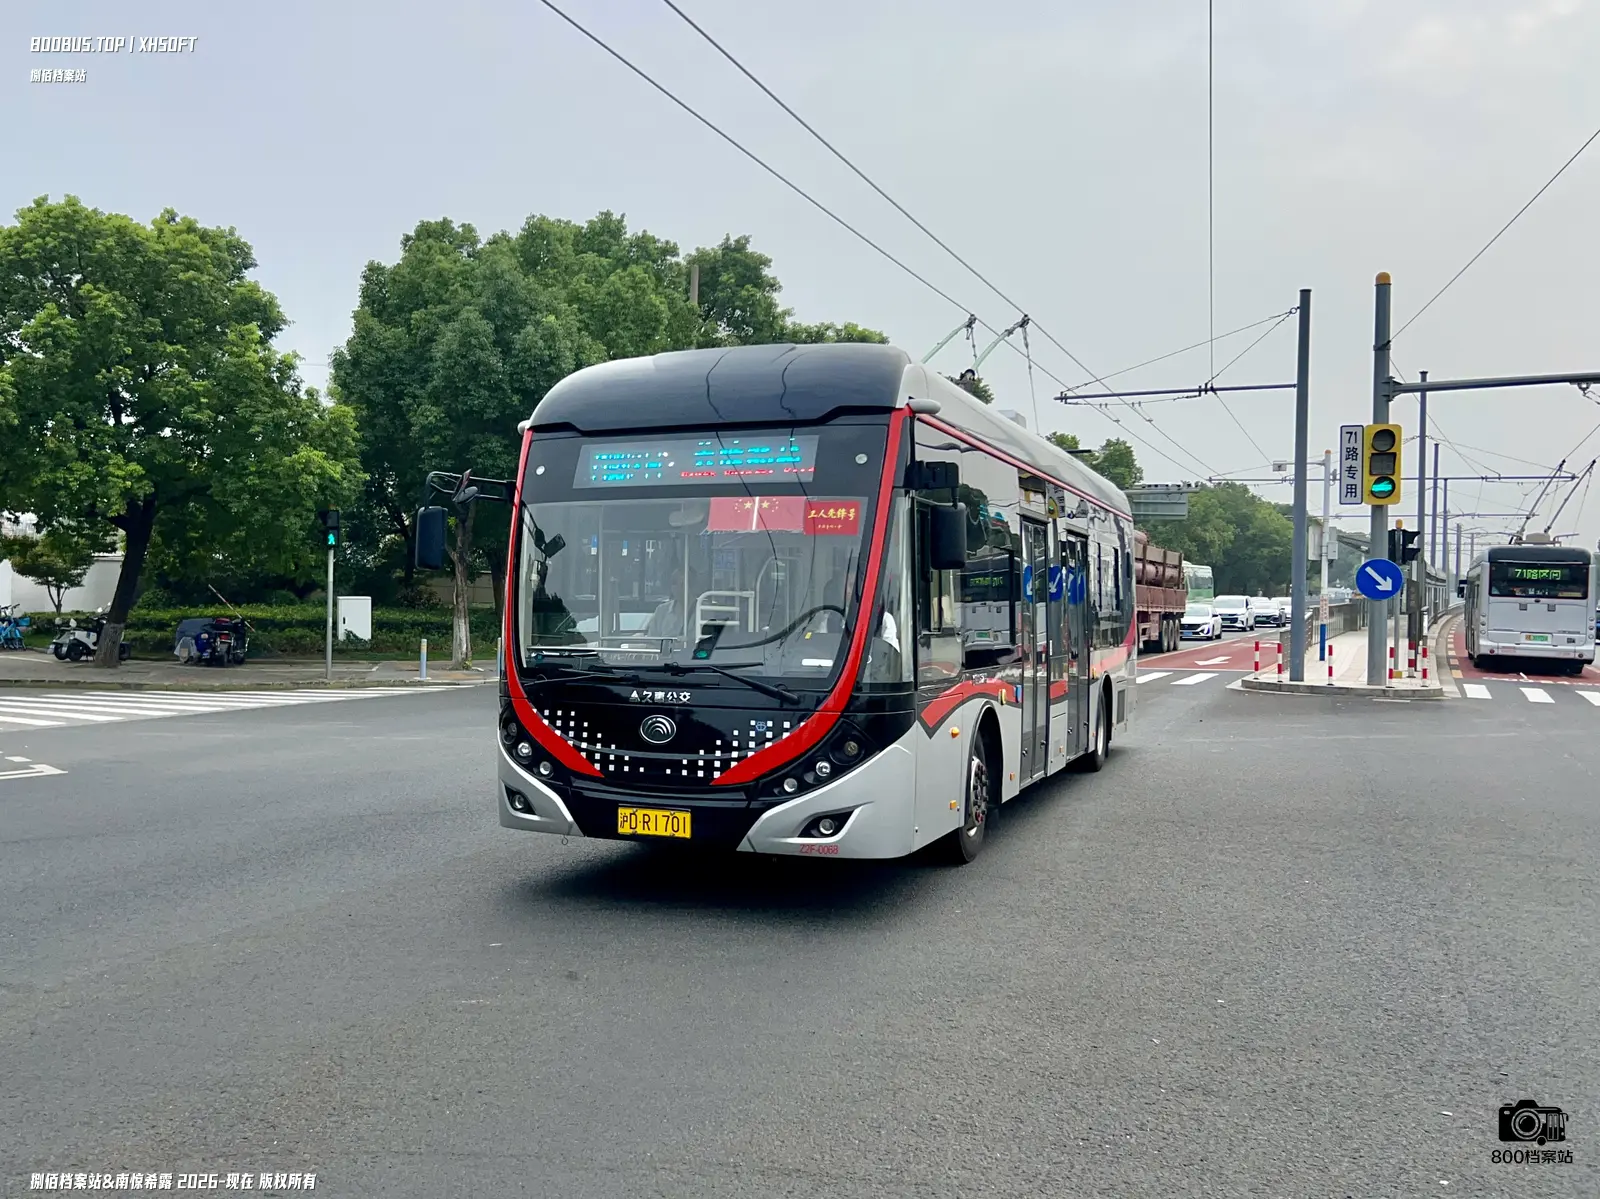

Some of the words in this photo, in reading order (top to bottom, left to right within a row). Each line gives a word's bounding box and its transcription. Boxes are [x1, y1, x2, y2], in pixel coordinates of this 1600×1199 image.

[1344, 431, 1359, 498] 71路专用
[807, 507, 856, 521] 工人先锋号
